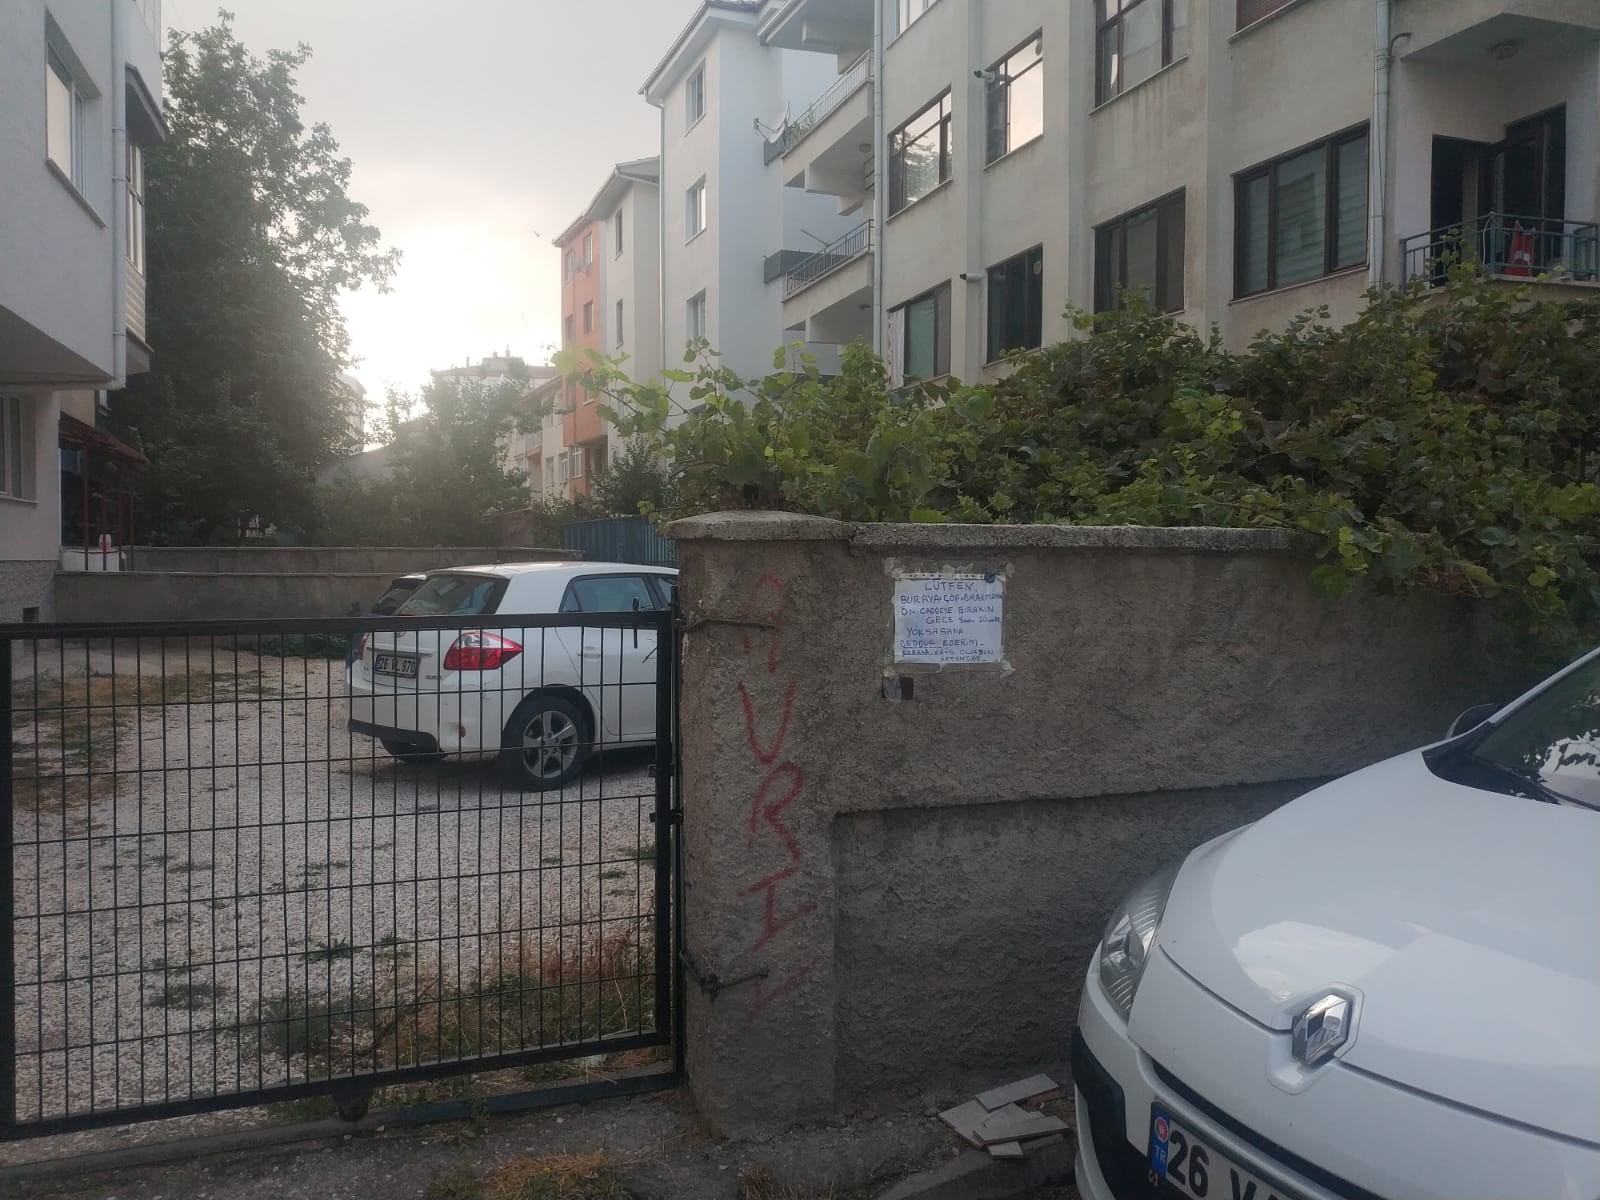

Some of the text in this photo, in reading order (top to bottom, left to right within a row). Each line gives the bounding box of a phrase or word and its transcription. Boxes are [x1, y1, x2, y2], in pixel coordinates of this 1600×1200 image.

[926, 616, 953, 625] GECE
[906, 627, 938, 638] YOKSA
[401, 659, 416, 674] 970
[1154, 1144, 1166, 1164] TR
[1167, 1130, 1210, 1198] 26
